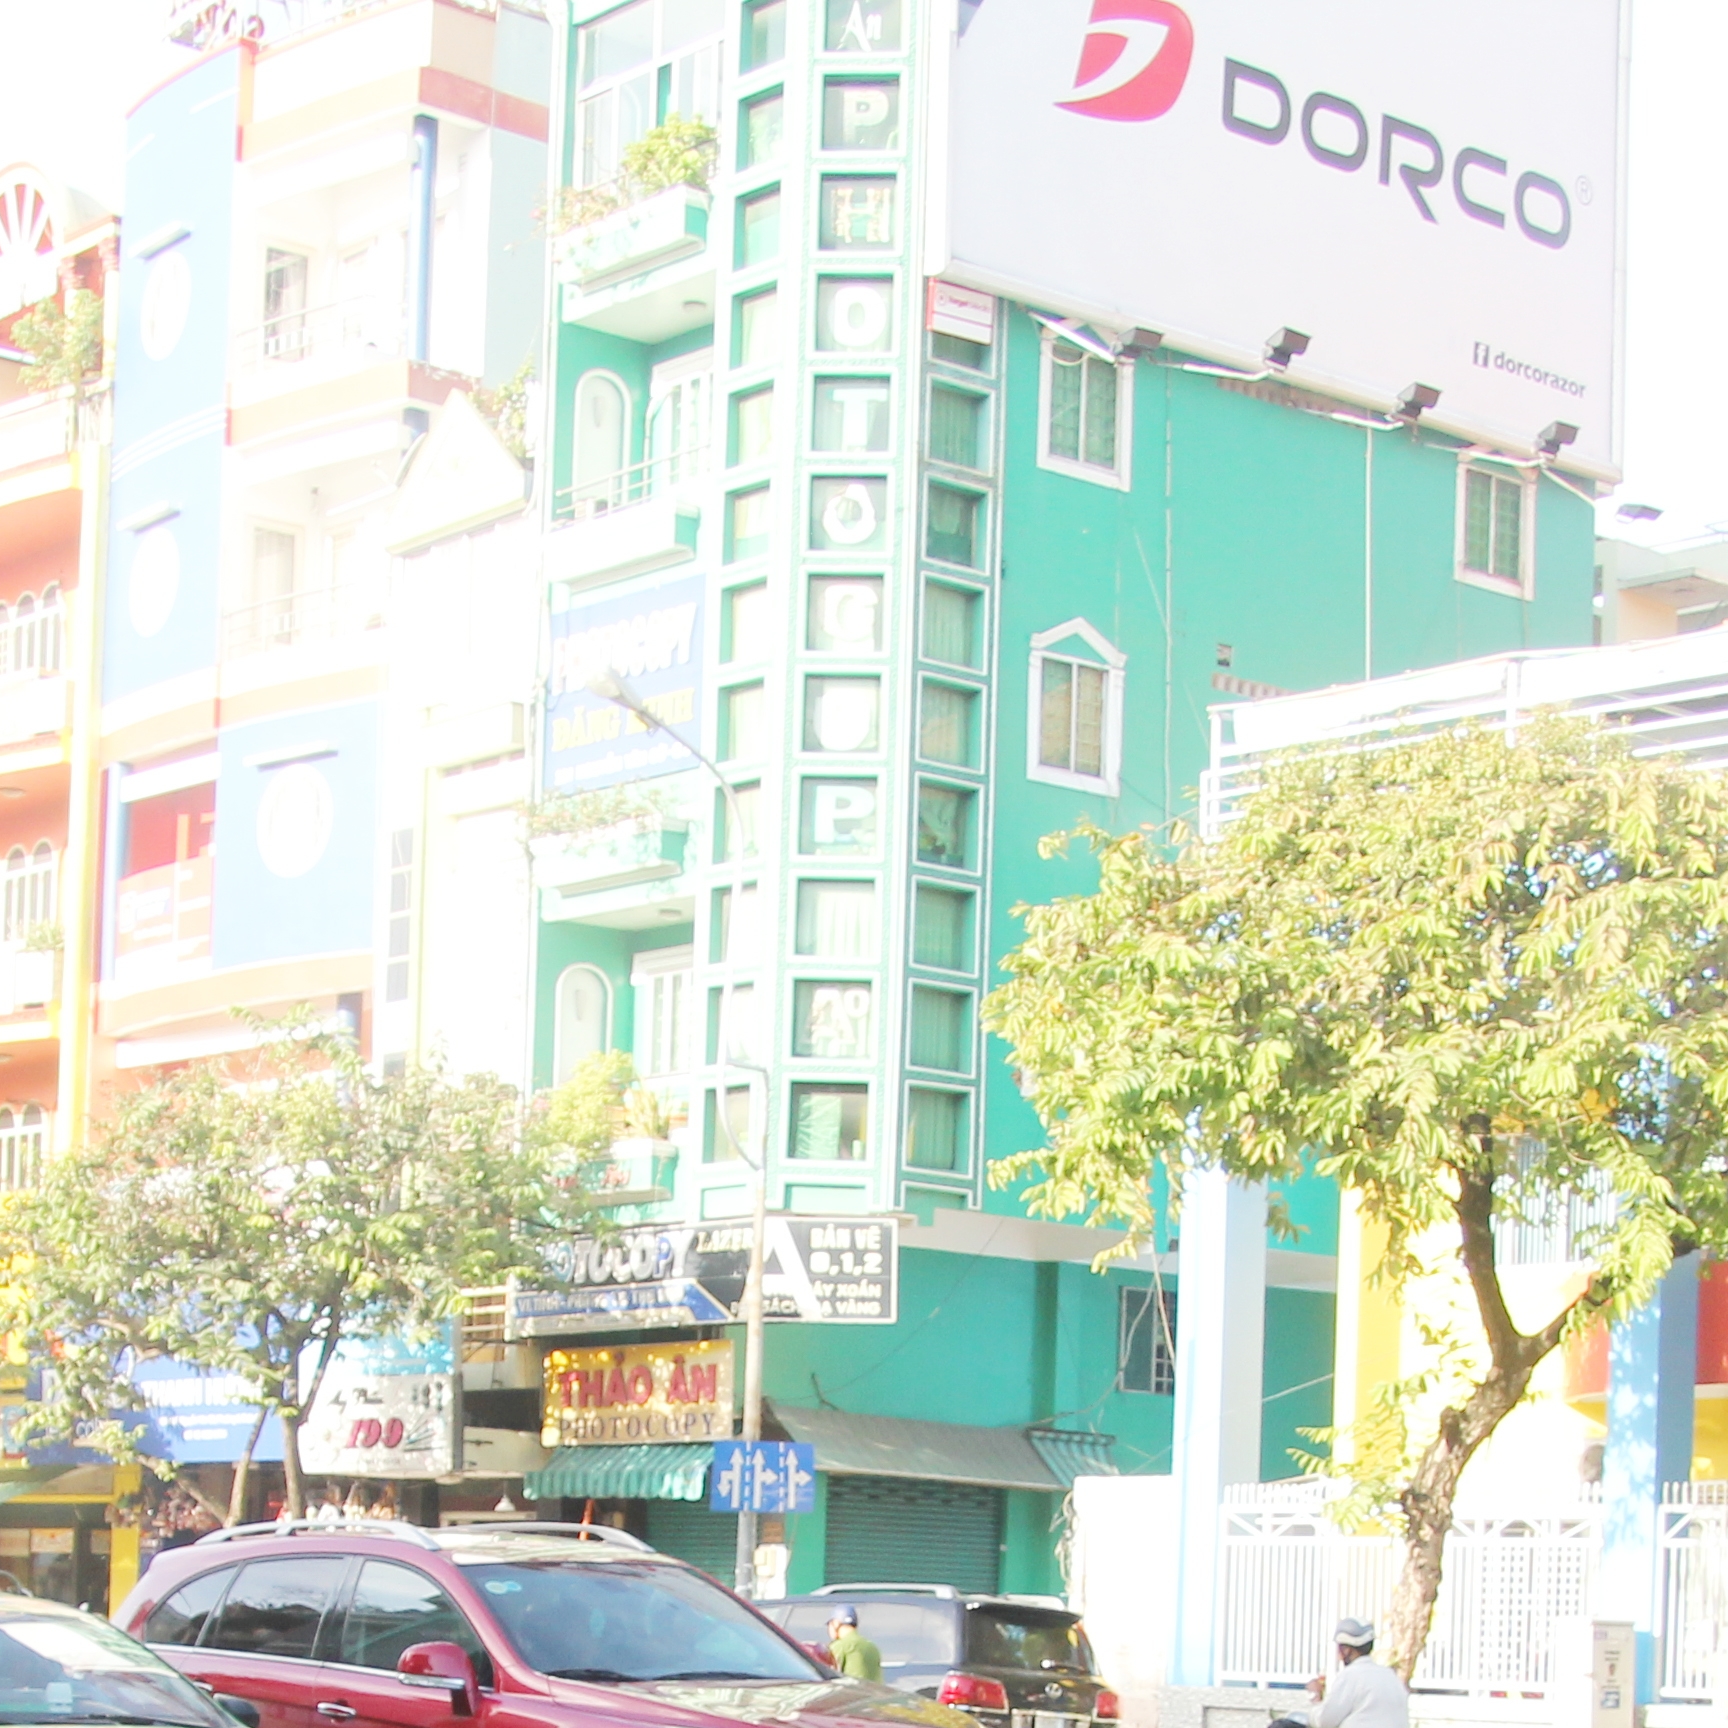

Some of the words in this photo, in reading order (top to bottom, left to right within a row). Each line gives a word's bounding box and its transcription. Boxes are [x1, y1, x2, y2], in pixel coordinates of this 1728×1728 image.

[1223, 56, 1572, 250] DORCO
[1493, 349, 1586, 399] dorcorazor
[558, 1350, 654, 1409] THẢO
[668, 1353, 719, 1405] ÂN
[558, 1411, 717, 1440] PHOTOCOPY
